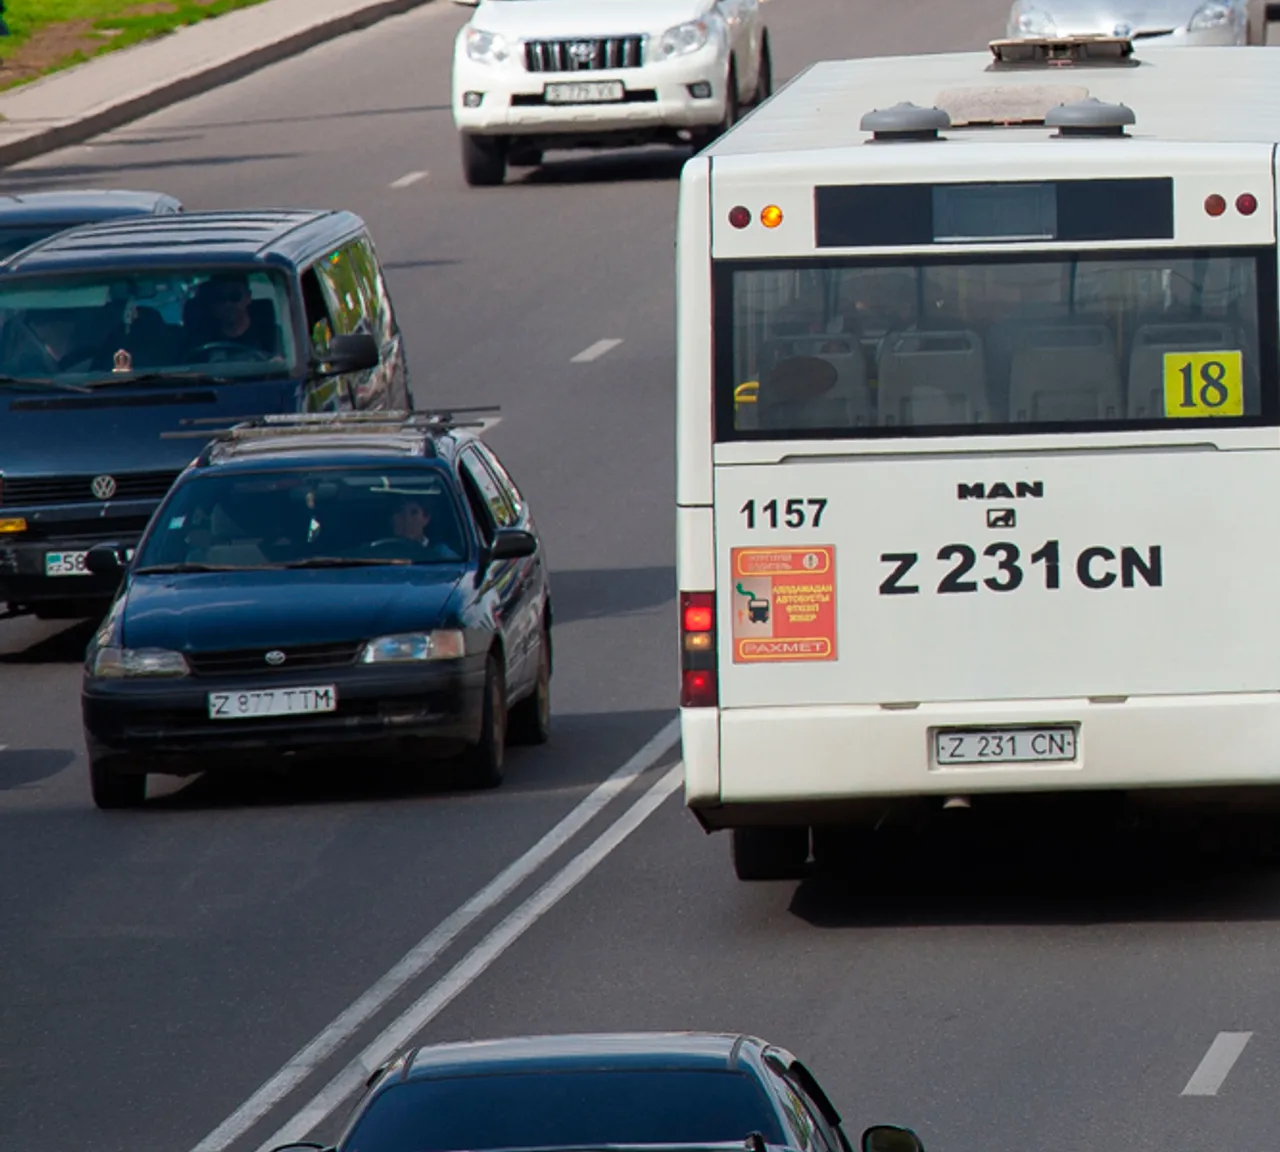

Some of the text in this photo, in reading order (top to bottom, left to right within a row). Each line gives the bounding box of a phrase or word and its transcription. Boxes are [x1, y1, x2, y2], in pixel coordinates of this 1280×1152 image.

[1178, 360, 1229, 408] 18
[957, 481, 1044, 500] MAN
[739, 498, 828, 529] 1157
[879, 540, 1163, 595] Z 231 CN
[745, 641, 825, 653] РАХМЕТ
[214, 689, 330, 715] Z 877 TTM
[948, 734, 1065, 758] Z 231 CN
